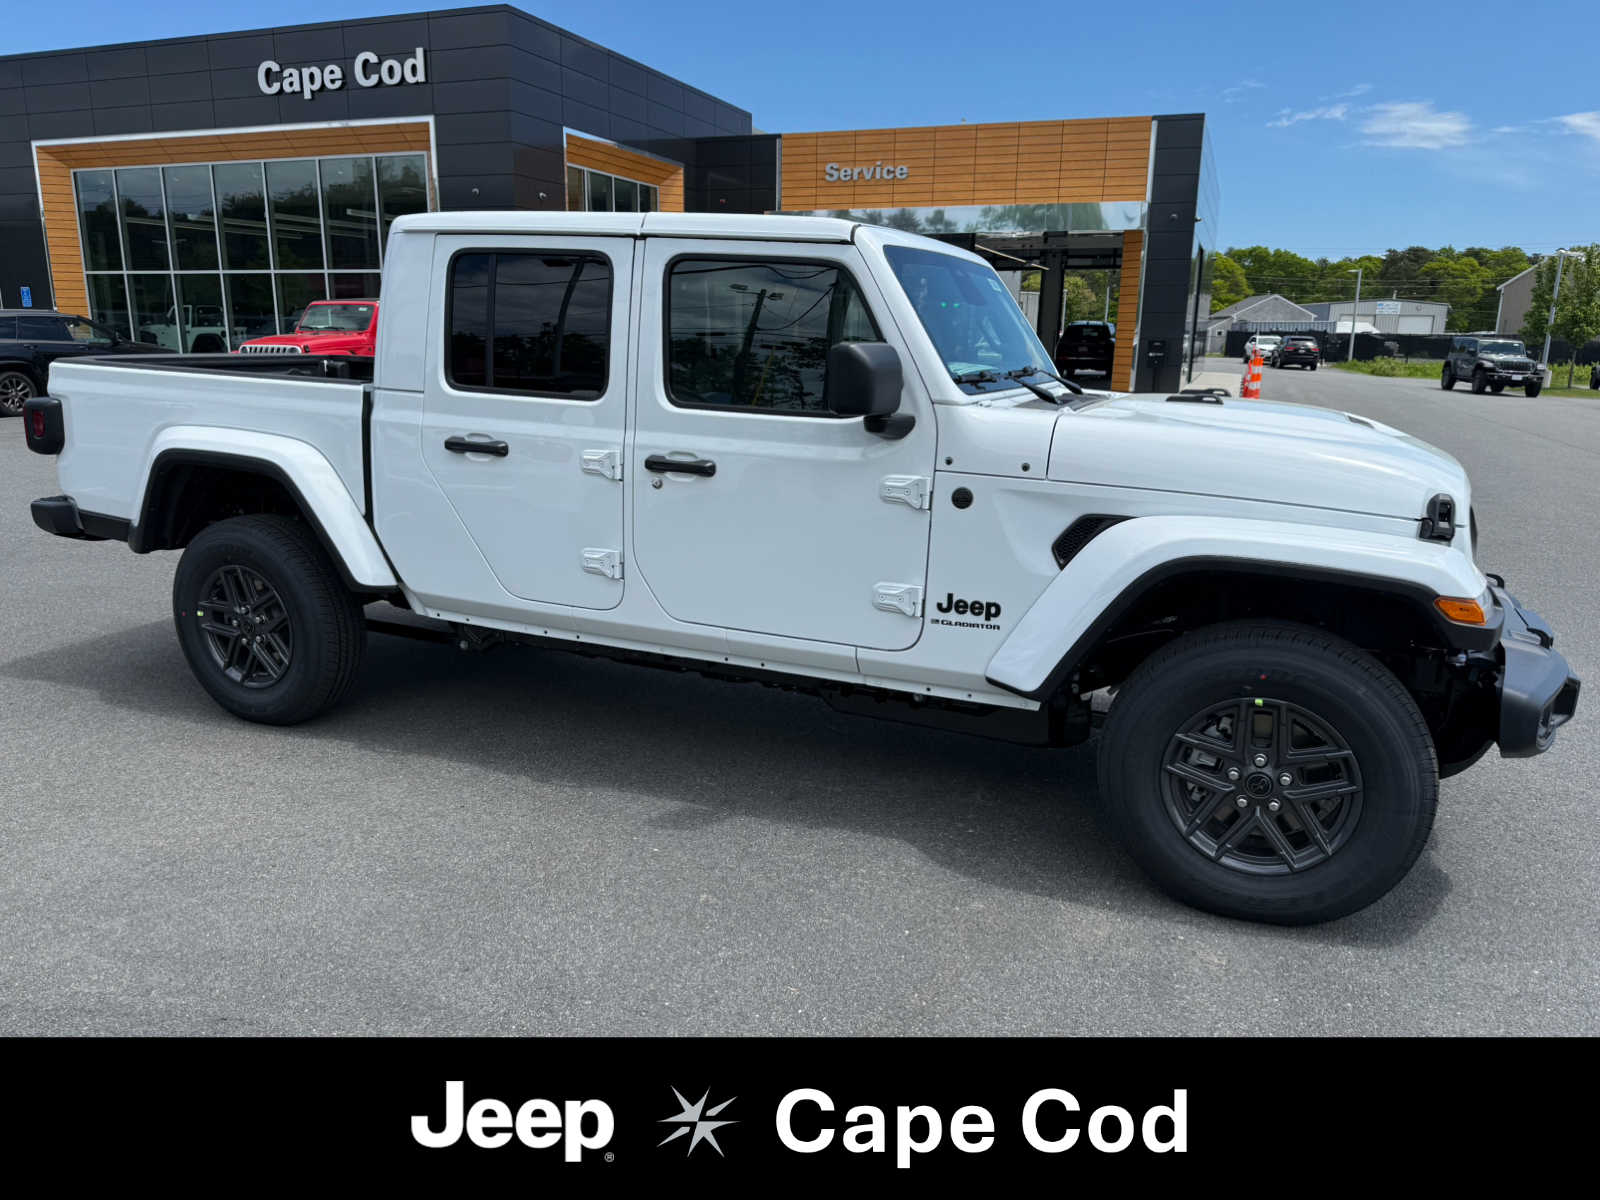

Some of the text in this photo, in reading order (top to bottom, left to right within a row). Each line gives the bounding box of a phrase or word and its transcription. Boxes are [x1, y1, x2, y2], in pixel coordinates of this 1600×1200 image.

[257, 47, 427, 100] Cape Cod
[825, 161, 909, 182] Service
[937, 593, 1001, 621] Jeep
[941, 619, 1001, 631] GLADIATOR
